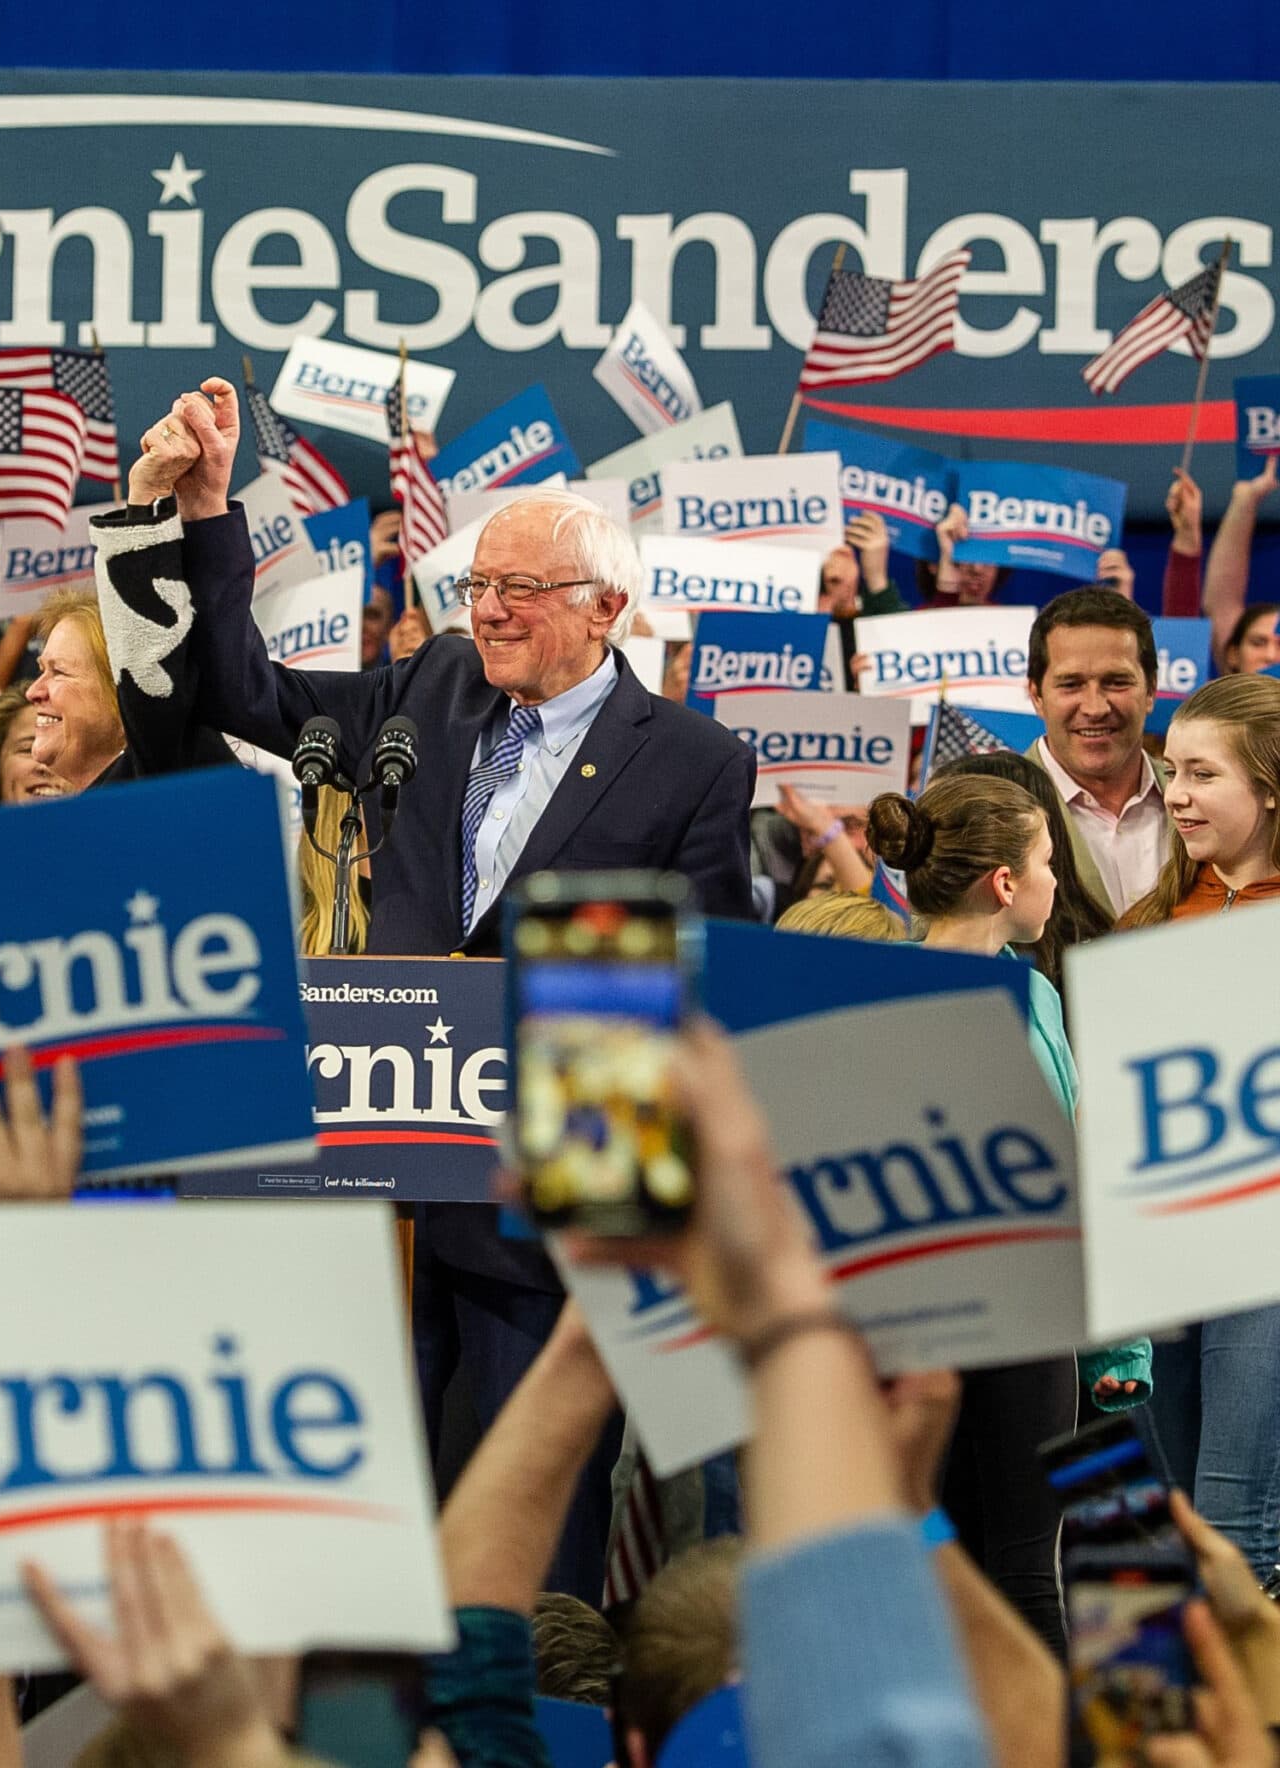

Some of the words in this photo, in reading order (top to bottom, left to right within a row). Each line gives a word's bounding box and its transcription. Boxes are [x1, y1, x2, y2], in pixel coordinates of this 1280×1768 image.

[295, 362, 428, 417] Berne
[622, 334, 692, 420] Bern
[437, 420, 554, 494] ernie
[678, 489, 828, 531] Bernie
[842, 465, 948, 523] ernie
[968, 490, 1111, 546] Bernie
[6, 544, 97, 580] Bern
[253, 515, 293, 563] nie
[651, 568, 802, 613] Bernie
[267, 608, 349, 660] rnie
[695, 643, 814, 691] Bernie
[875, 641, 1027, 683] Bernie
[298, 982, 439, 1005] Sanders.com
[304, 1015, 508, 1122] rnie
[341, 1177, 353, 1187] the
[782, 1107, 1068, 1253] rnie
